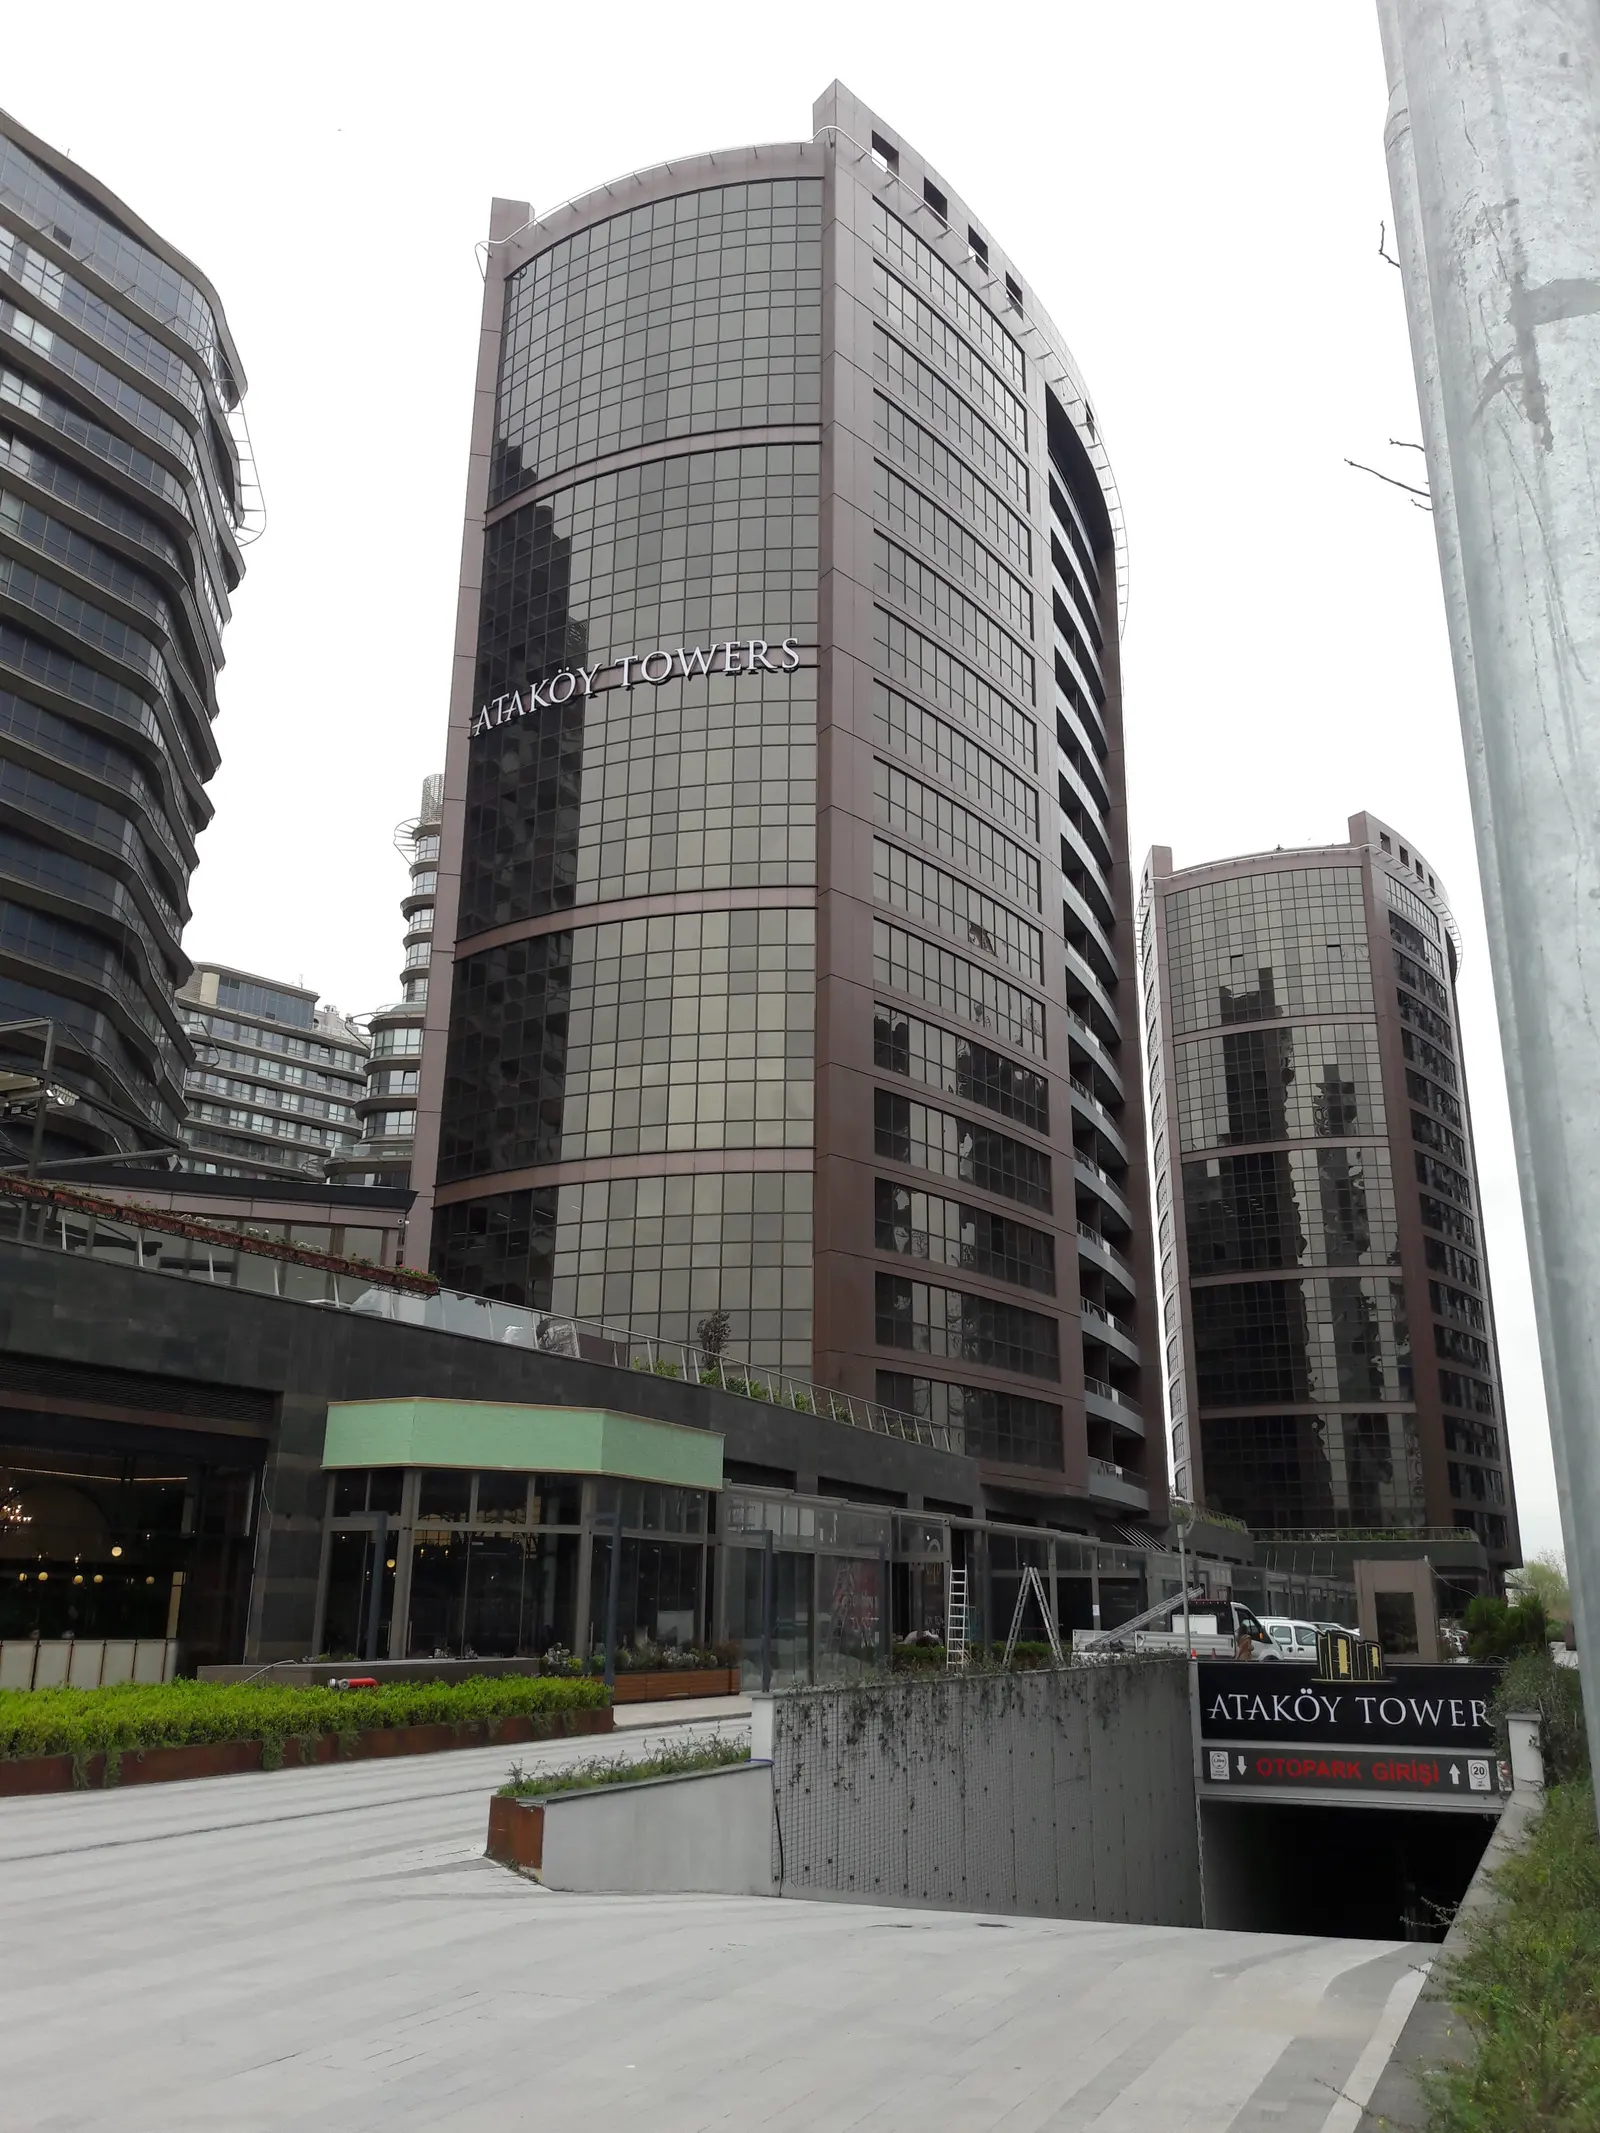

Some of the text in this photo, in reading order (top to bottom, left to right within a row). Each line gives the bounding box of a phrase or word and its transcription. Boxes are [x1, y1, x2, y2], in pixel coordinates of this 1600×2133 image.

[472, 637, 800, 737] ATAKÖY TOWERS
[1206, 1688, 1496, 1728] ATAKÖY TOWER
[1256, 1756, 1439, 1787] OTOPARK GİRİŞİ
[1473, 1766, 1485, 1776] 20
